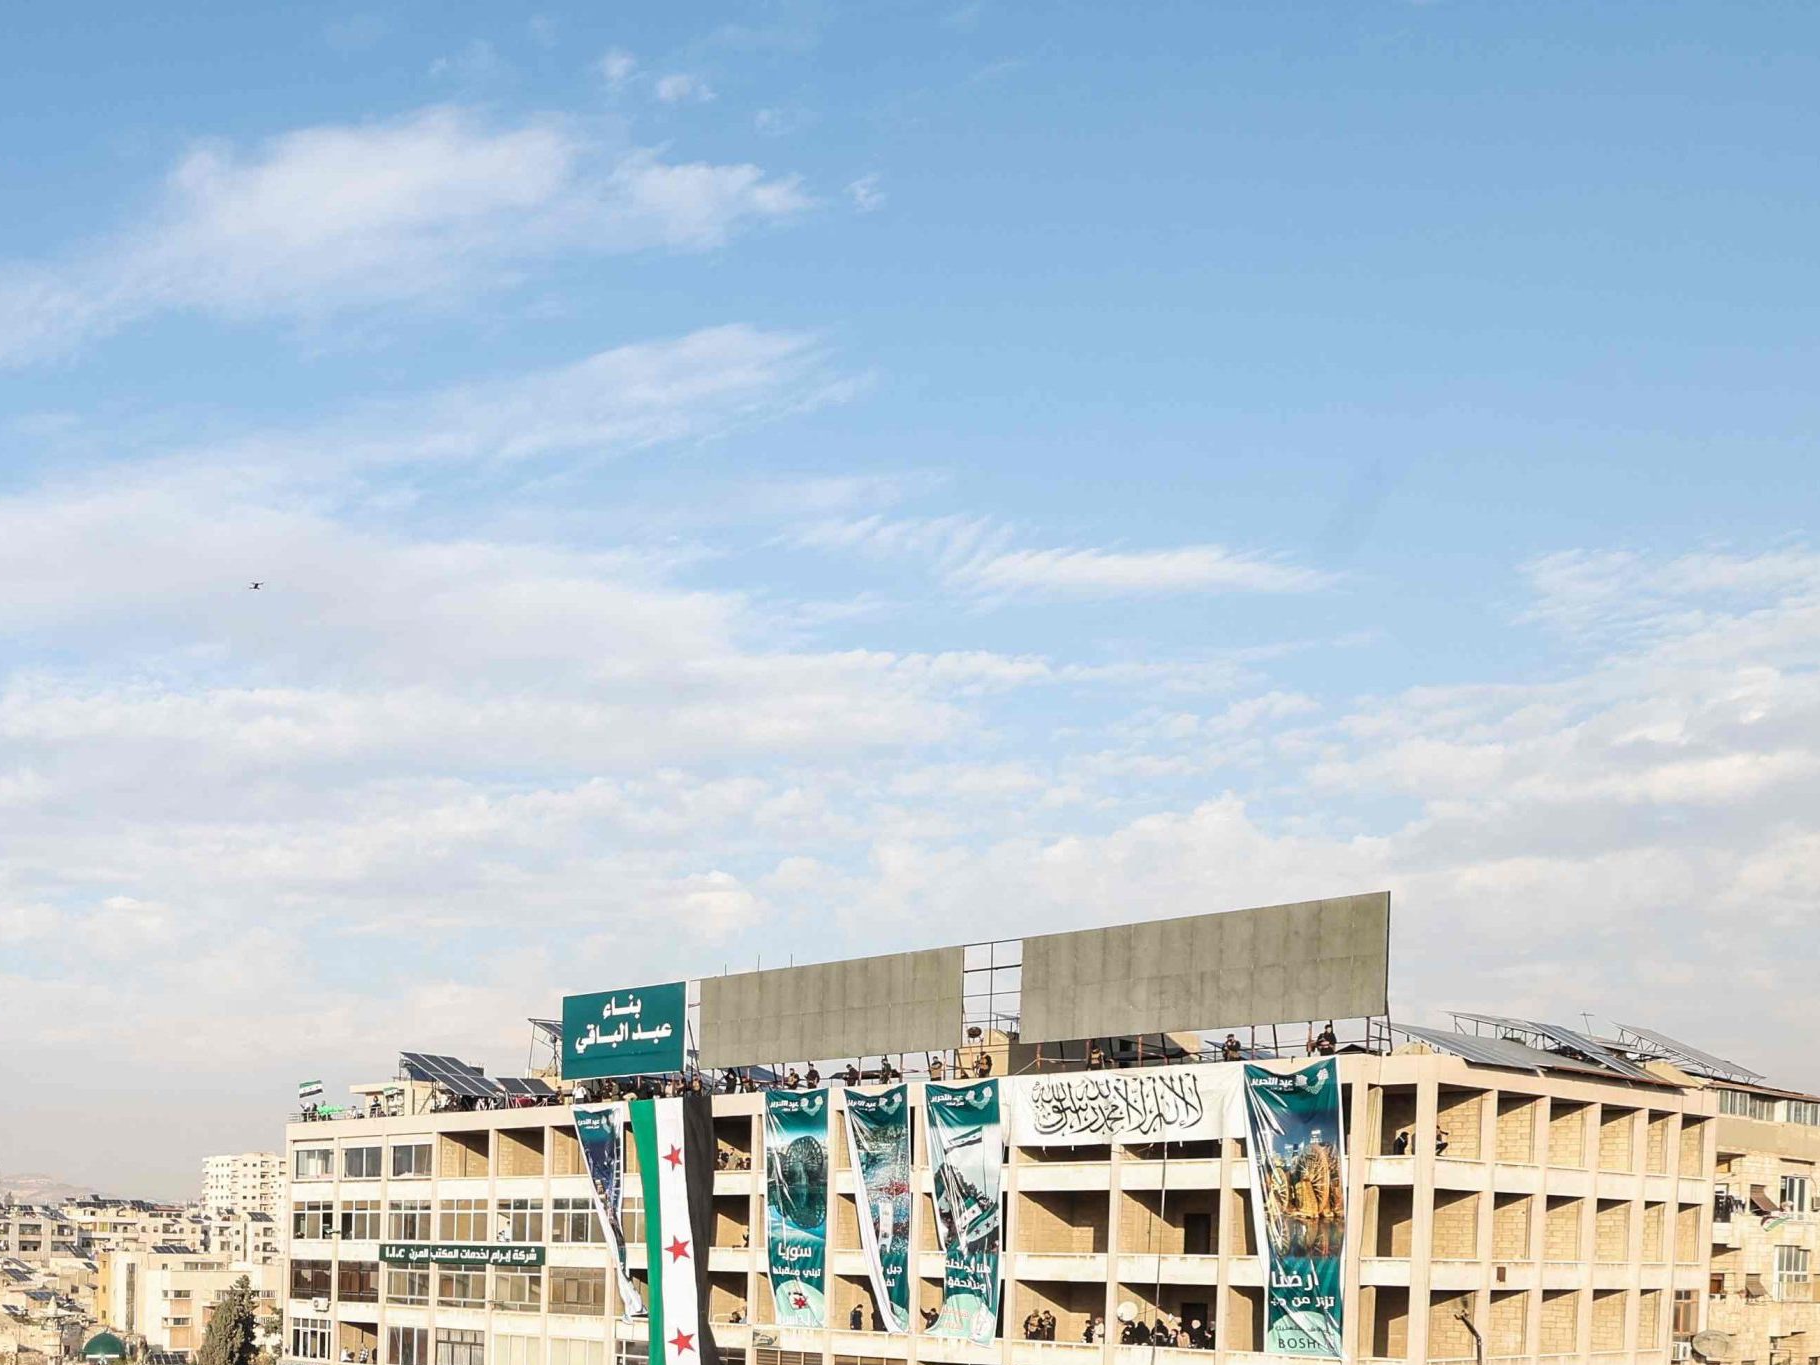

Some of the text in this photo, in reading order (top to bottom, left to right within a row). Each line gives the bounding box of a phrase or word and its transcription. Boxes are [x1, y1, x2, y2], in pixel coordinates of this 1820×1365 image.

[603, 994, 641, 1019] بناء
[575, 1021, 672, 1054] عبد الباقي
[460, 1249, 489, 1260] لخدمات
[512, 1248, 536, 1263] شركة
[778, 1242, 812, 1261] سوريا
